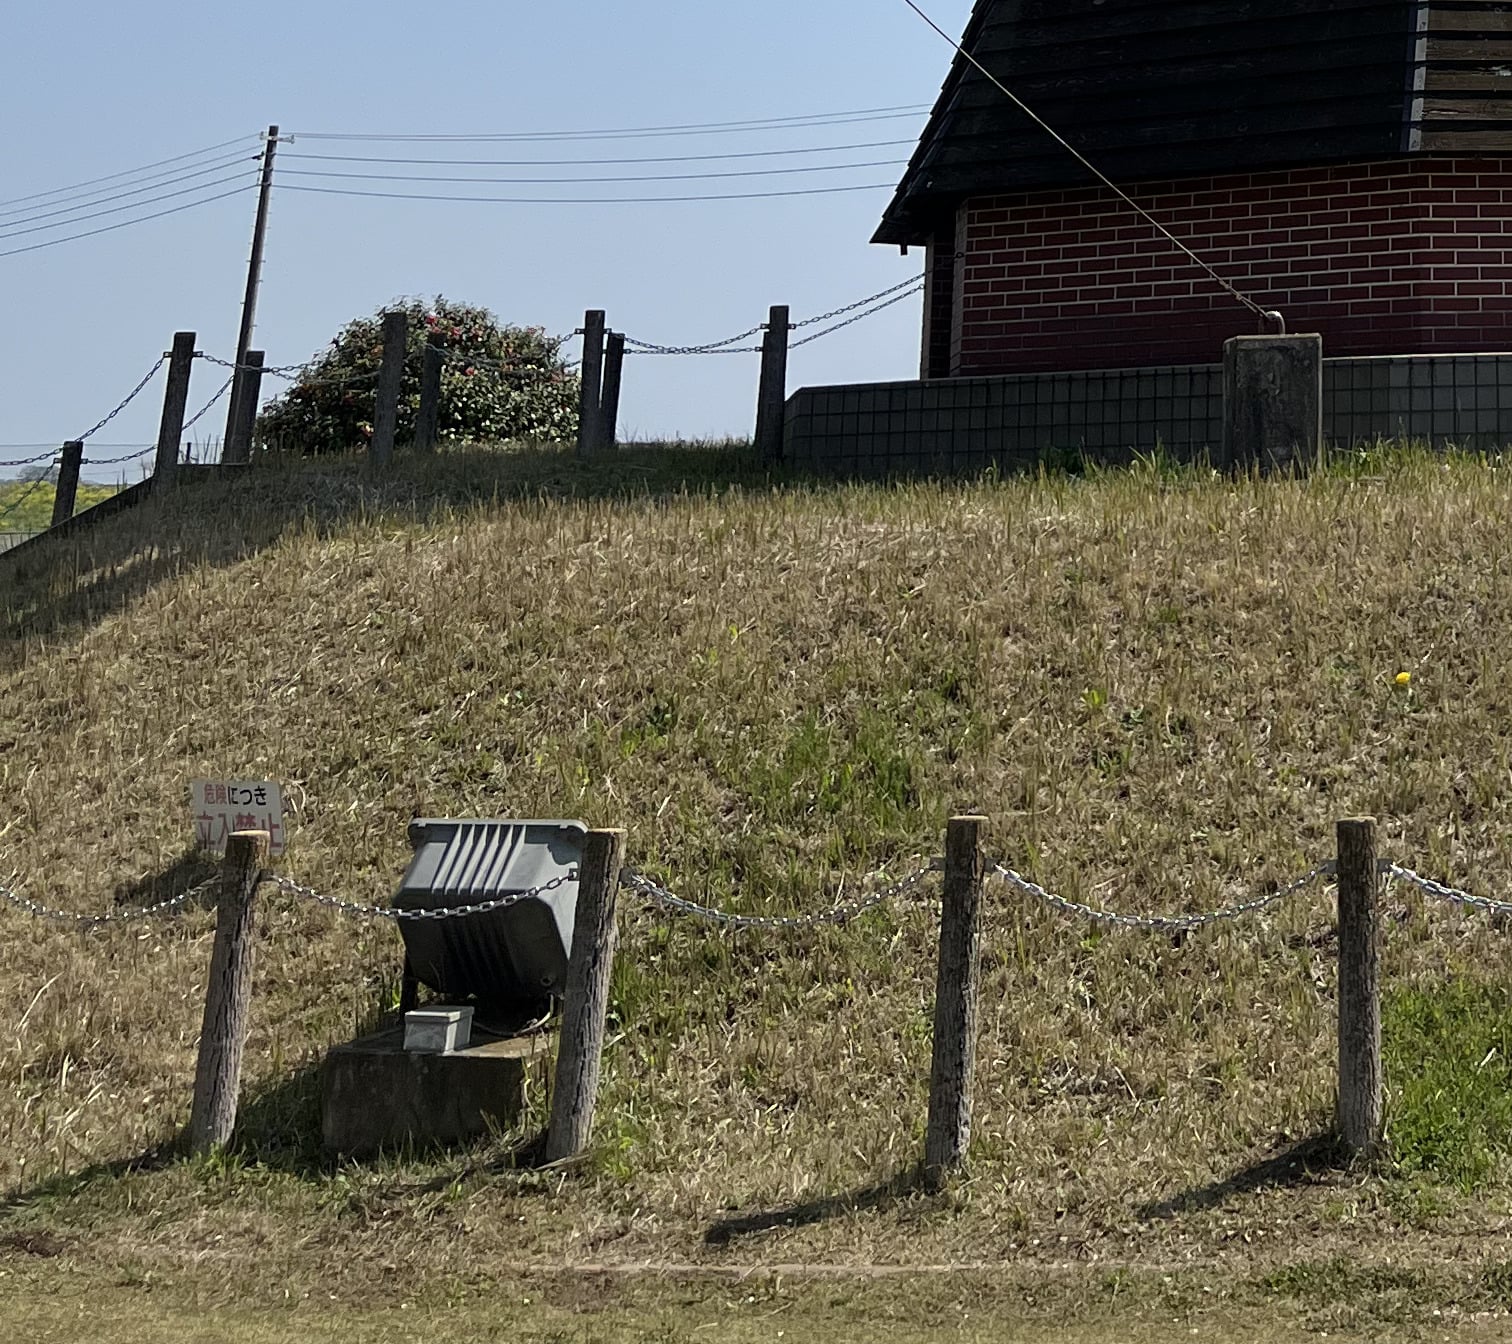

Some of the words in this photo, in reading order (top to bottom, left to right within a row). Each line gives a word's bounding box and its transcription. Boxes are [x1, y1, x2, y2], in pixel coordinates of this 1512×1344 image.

[204, 783, 267, 806] 危険につき
